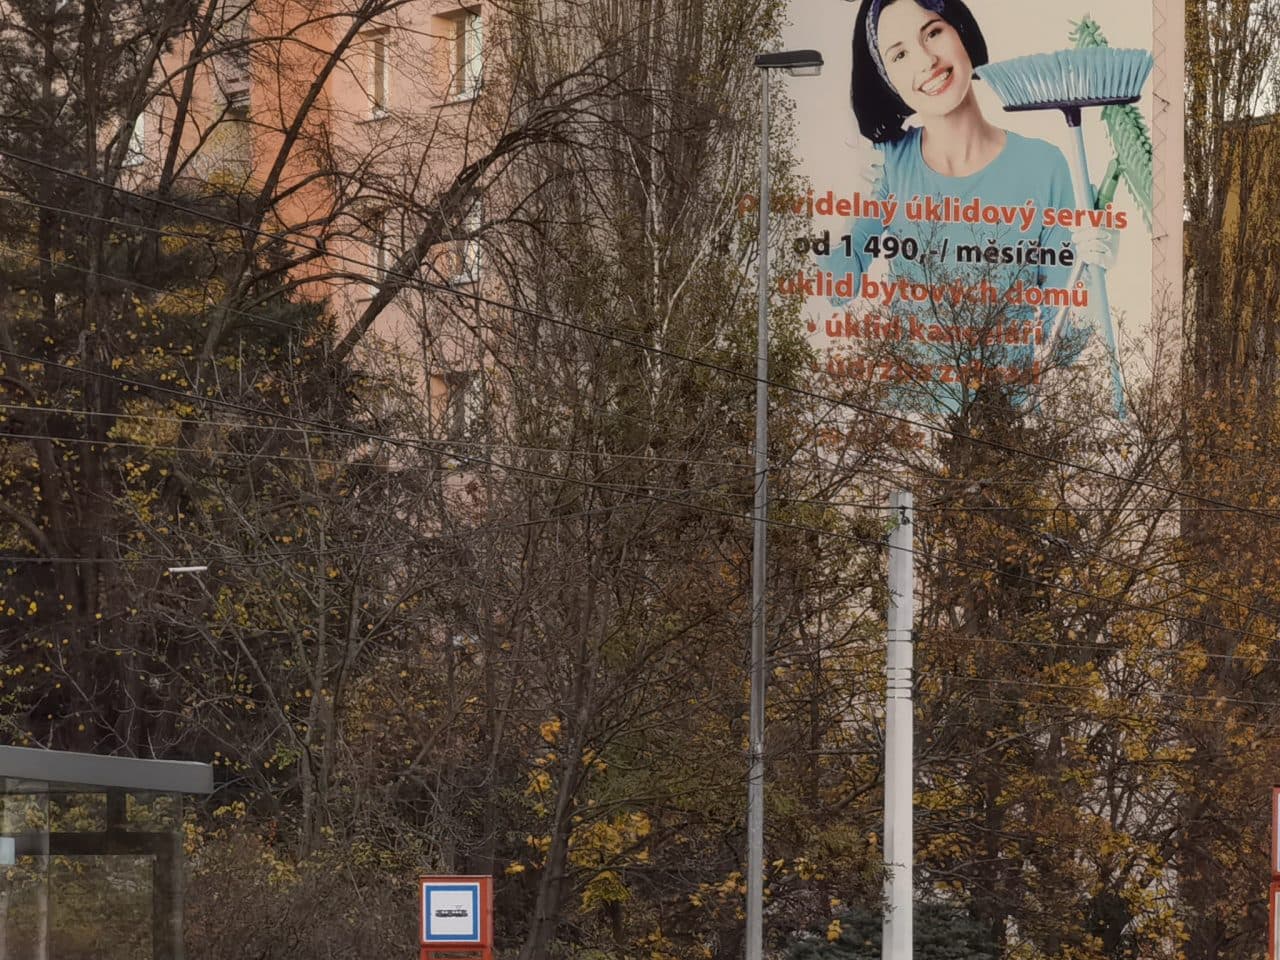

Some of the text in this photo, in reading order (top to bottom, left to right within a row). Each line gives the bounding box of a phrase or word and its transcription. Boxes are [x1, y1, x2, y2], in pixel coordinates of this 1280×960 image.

[738, 191, 1128, 232] pvidelný úklidový servis
[793, 230, 831, 256] od
[841, 235, 852, 257] 1
[956, 239, 1074, 266] měsíčně
[1006, 279, 1088, 307] domů
